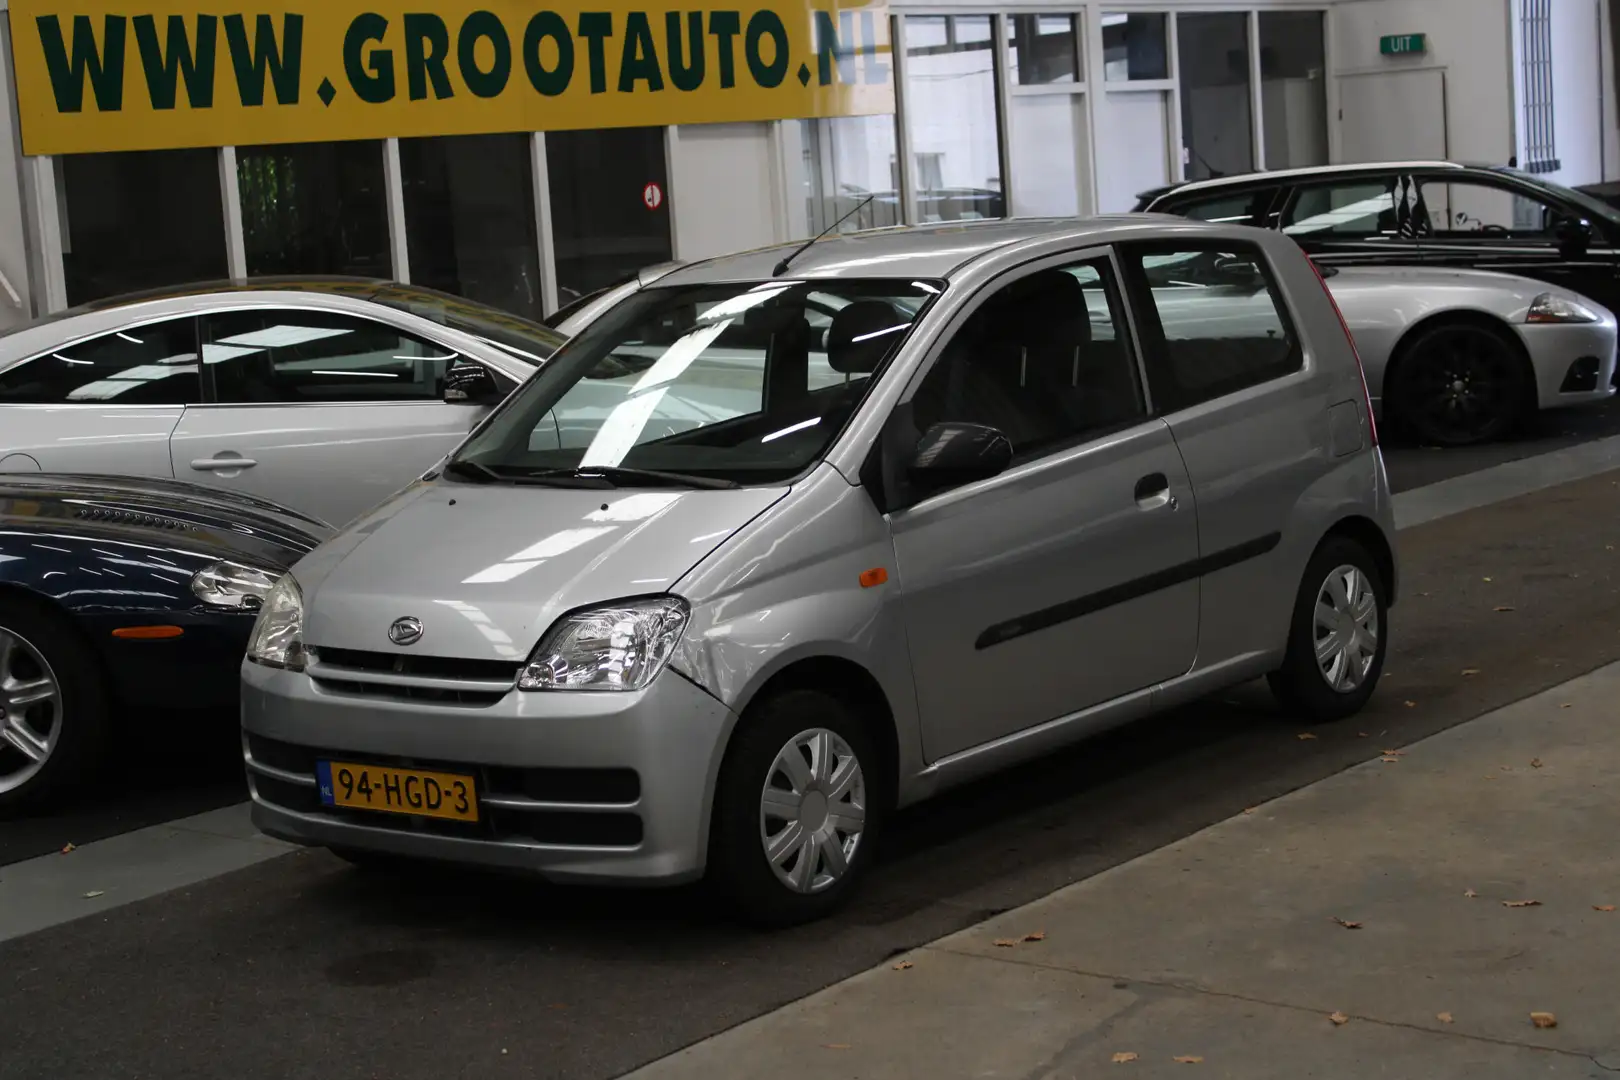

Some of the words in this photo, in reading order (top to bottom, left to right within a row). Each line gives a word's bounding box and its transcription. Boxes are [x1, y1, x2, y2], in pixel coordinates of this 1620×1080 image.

[1391, 36, 1411, 52] UIT
[36, 9, 889, 113] WWW.GROOTAUTO.NL
[320, 785, 332, 797] NL
[338, 768, 469, 814] 94-HGD-3
